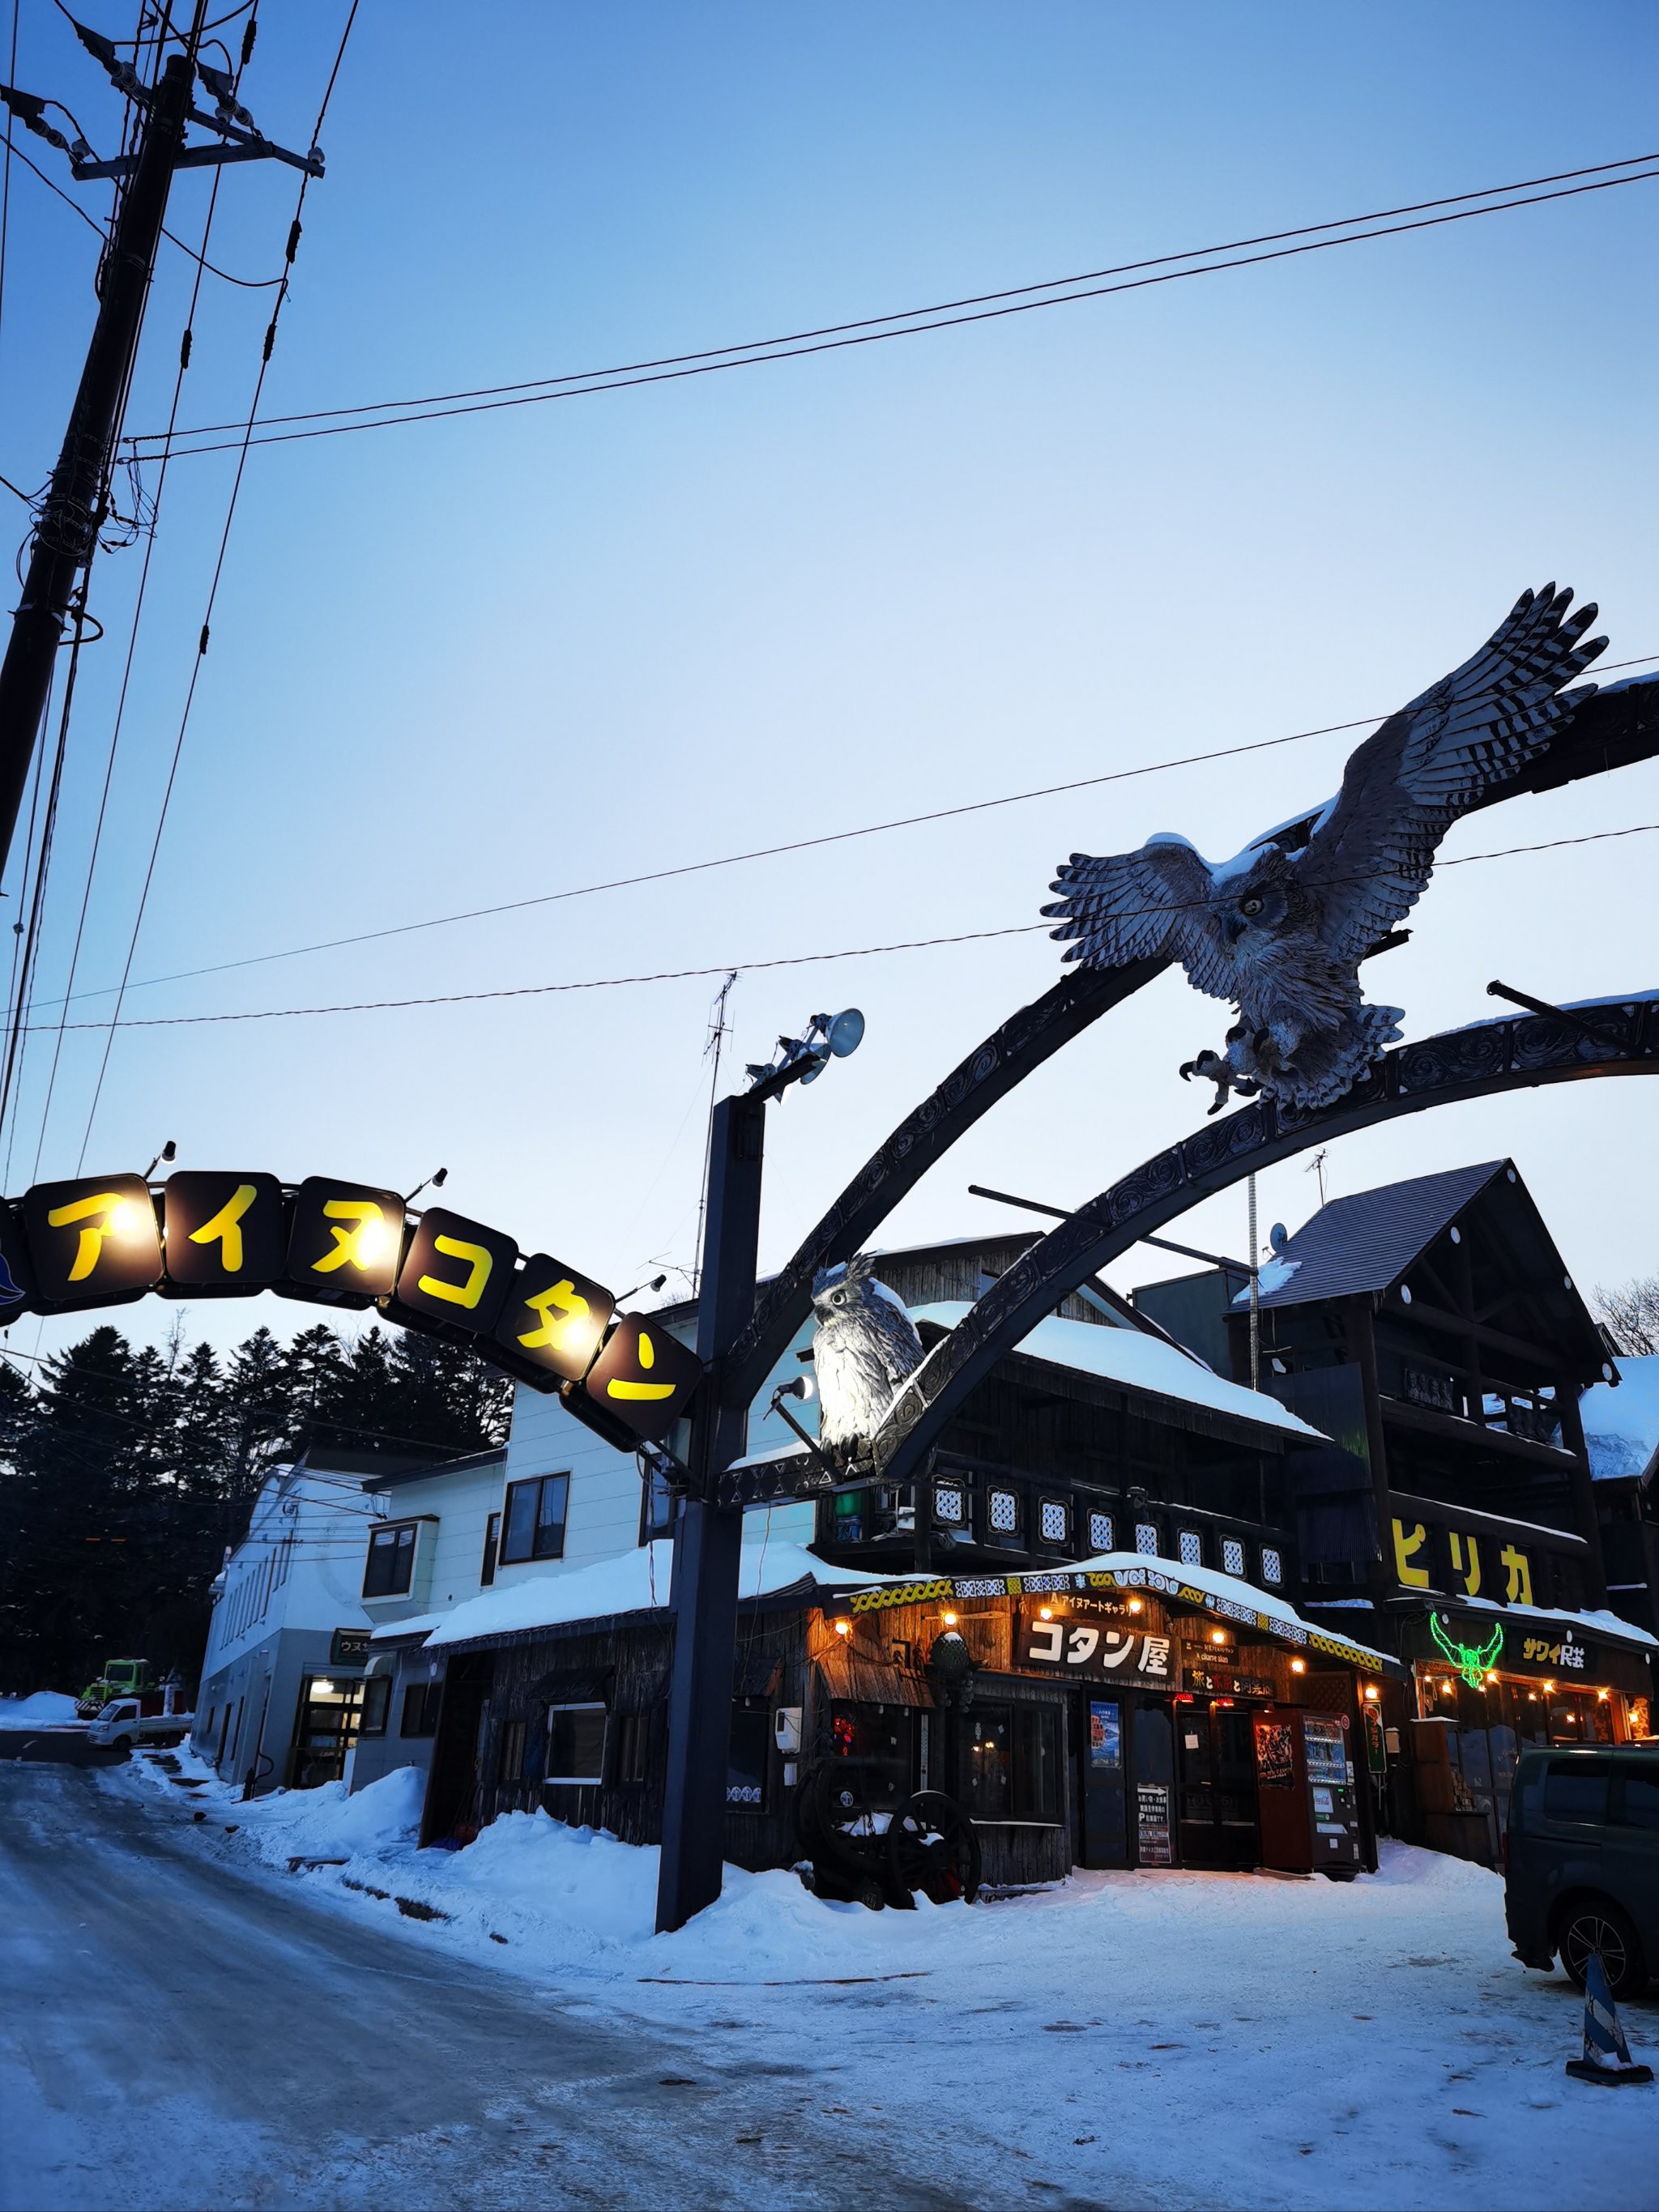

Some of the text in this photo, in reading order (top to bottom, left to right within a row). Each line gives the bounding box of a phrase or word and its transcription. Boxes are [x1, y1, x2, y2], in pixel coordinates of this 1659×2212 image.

[48, 1184, 676, 1401] アイヌコタン
[1392, 1518, 1533, 1606] ピリカ
[1061, 1595, 1140, 1617] アイヌアートギャラリ
[1029, 1621, 1171, 1677] コタン屋
[1522, 1637, 1585, 1669] サワイ民芸
